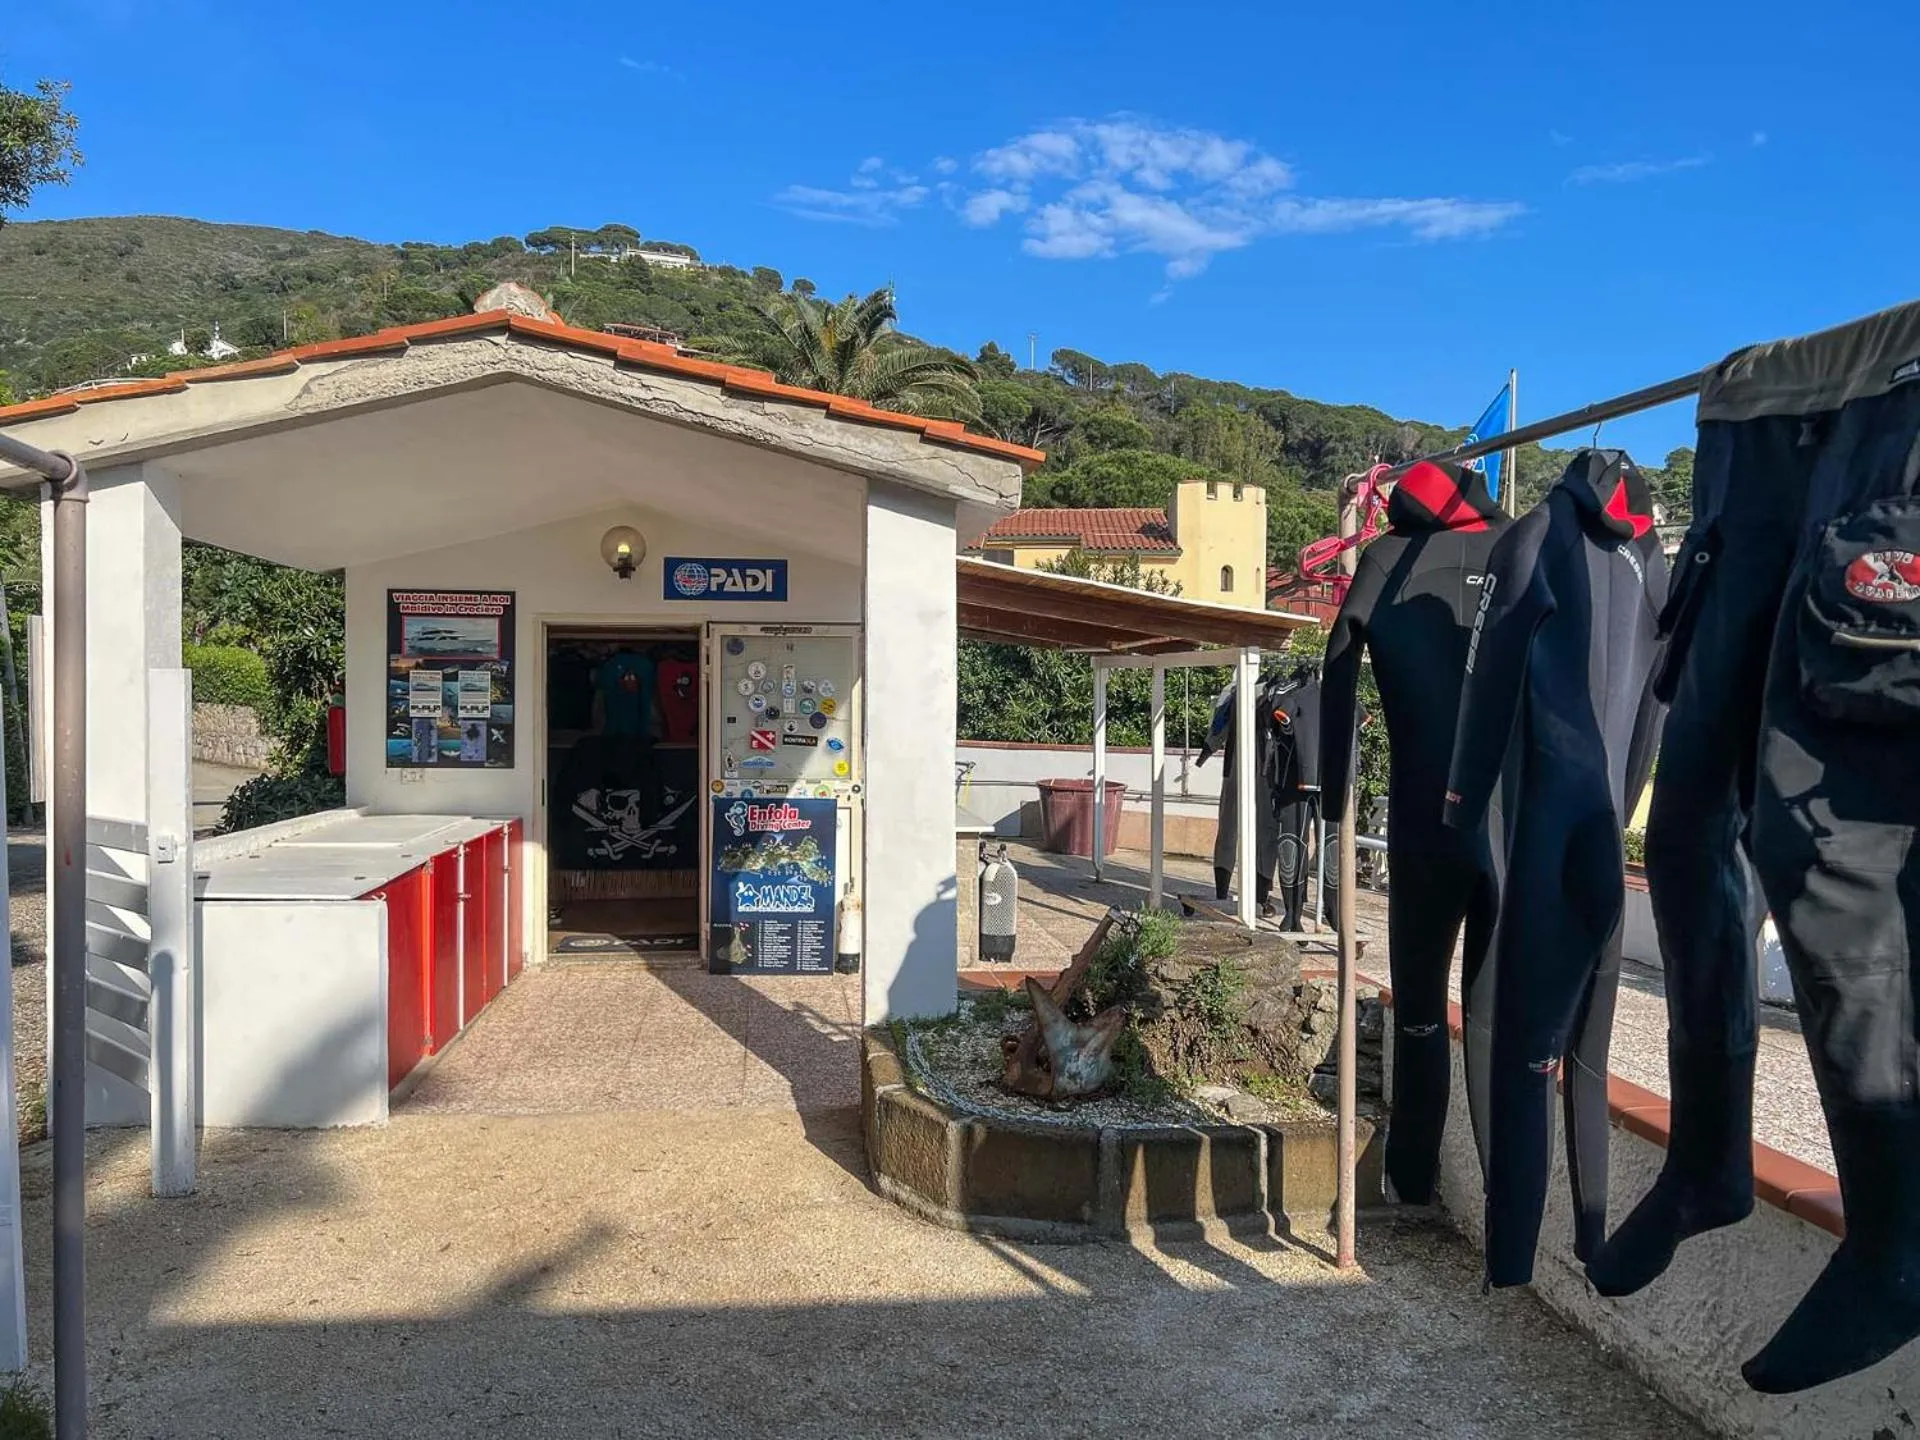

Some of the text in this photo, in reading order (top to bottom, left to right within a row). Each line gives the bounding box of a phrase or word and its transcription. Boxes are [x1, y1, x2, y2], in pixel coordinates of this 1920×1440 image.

[709, 567, 773, 593] PADI
[393, 593, 511, 605] VIAGGIA INSIEME A NOI
[400, 604, 504, 615] Maldive in Crociera
[1465, 572, 1498, 675] CRESSI
[749, 803, 799, 821] Enfola
[750, 819, 811, 832] Diving Center
